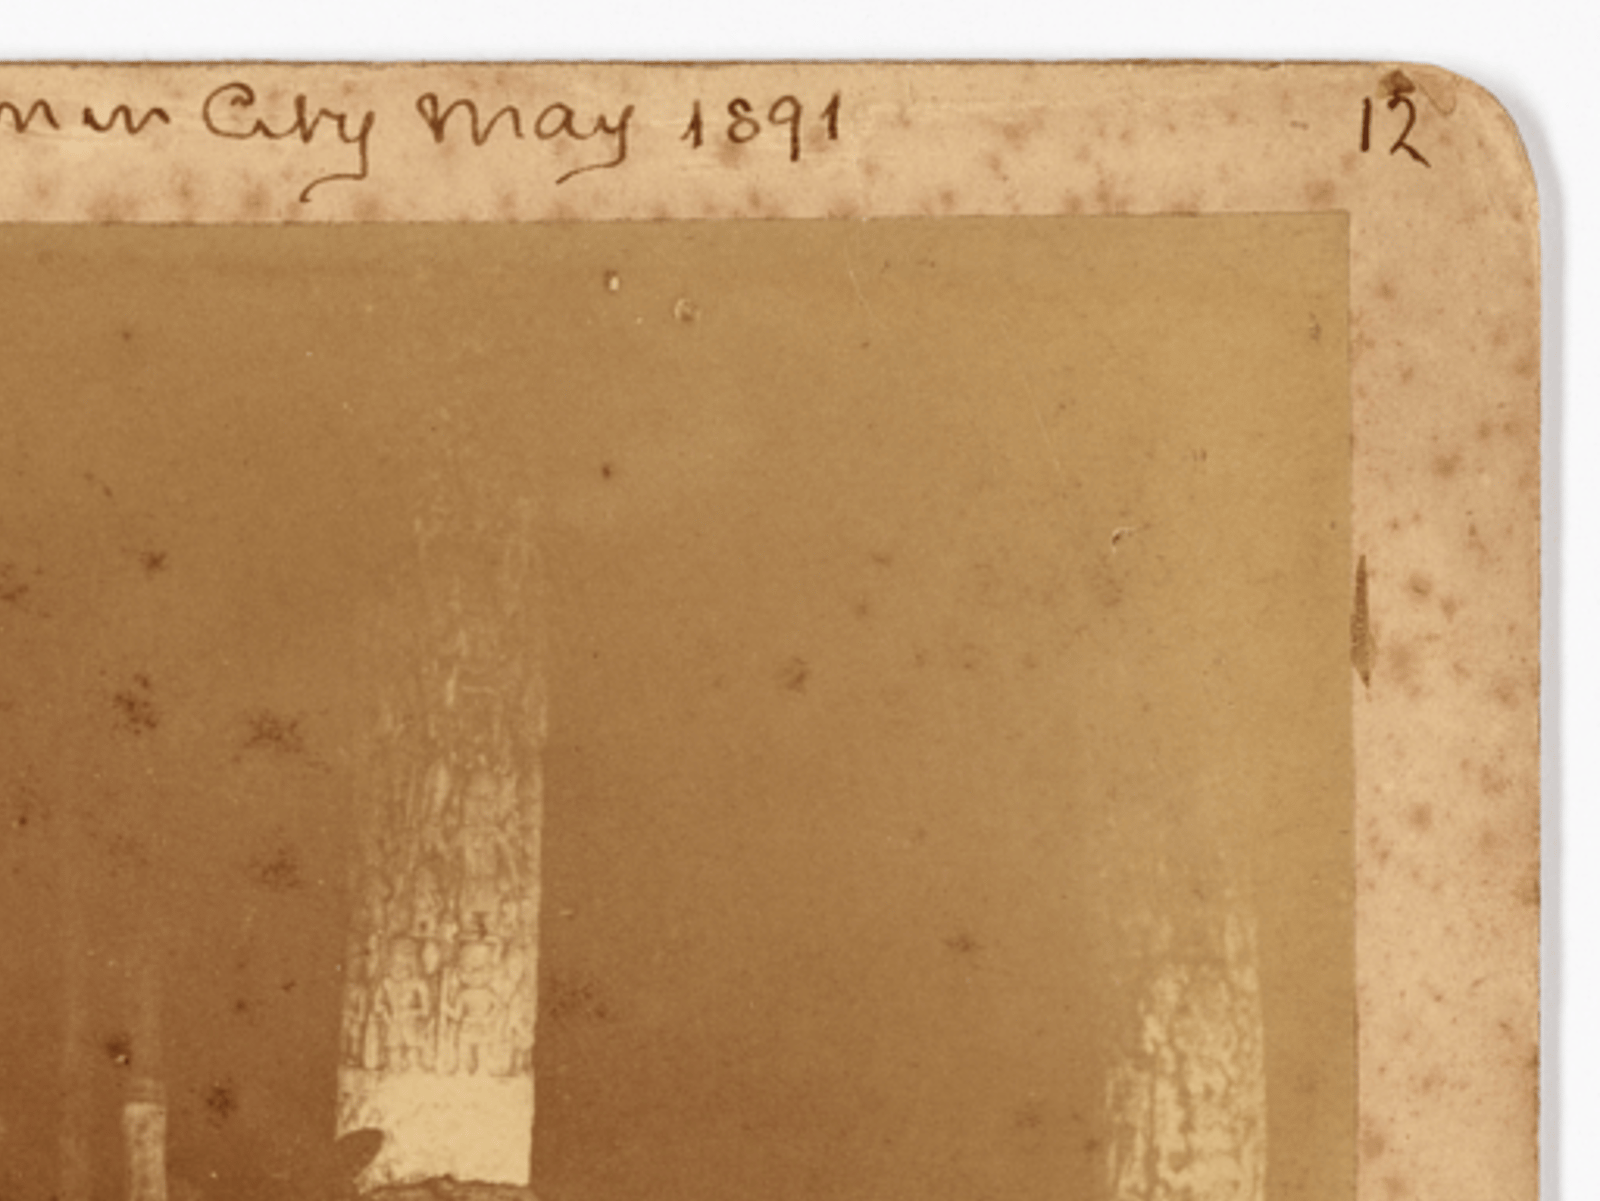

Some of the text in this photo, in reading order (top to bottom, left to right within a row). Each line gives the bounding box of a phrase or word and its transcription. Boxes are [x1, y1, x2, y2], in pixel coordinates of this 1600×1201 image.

[202, 82, 375, 203] City
[415, 92, 635, 185] May
[680, 92, 841, 162] 1891
[1359, 95, 1432, 168] 12
